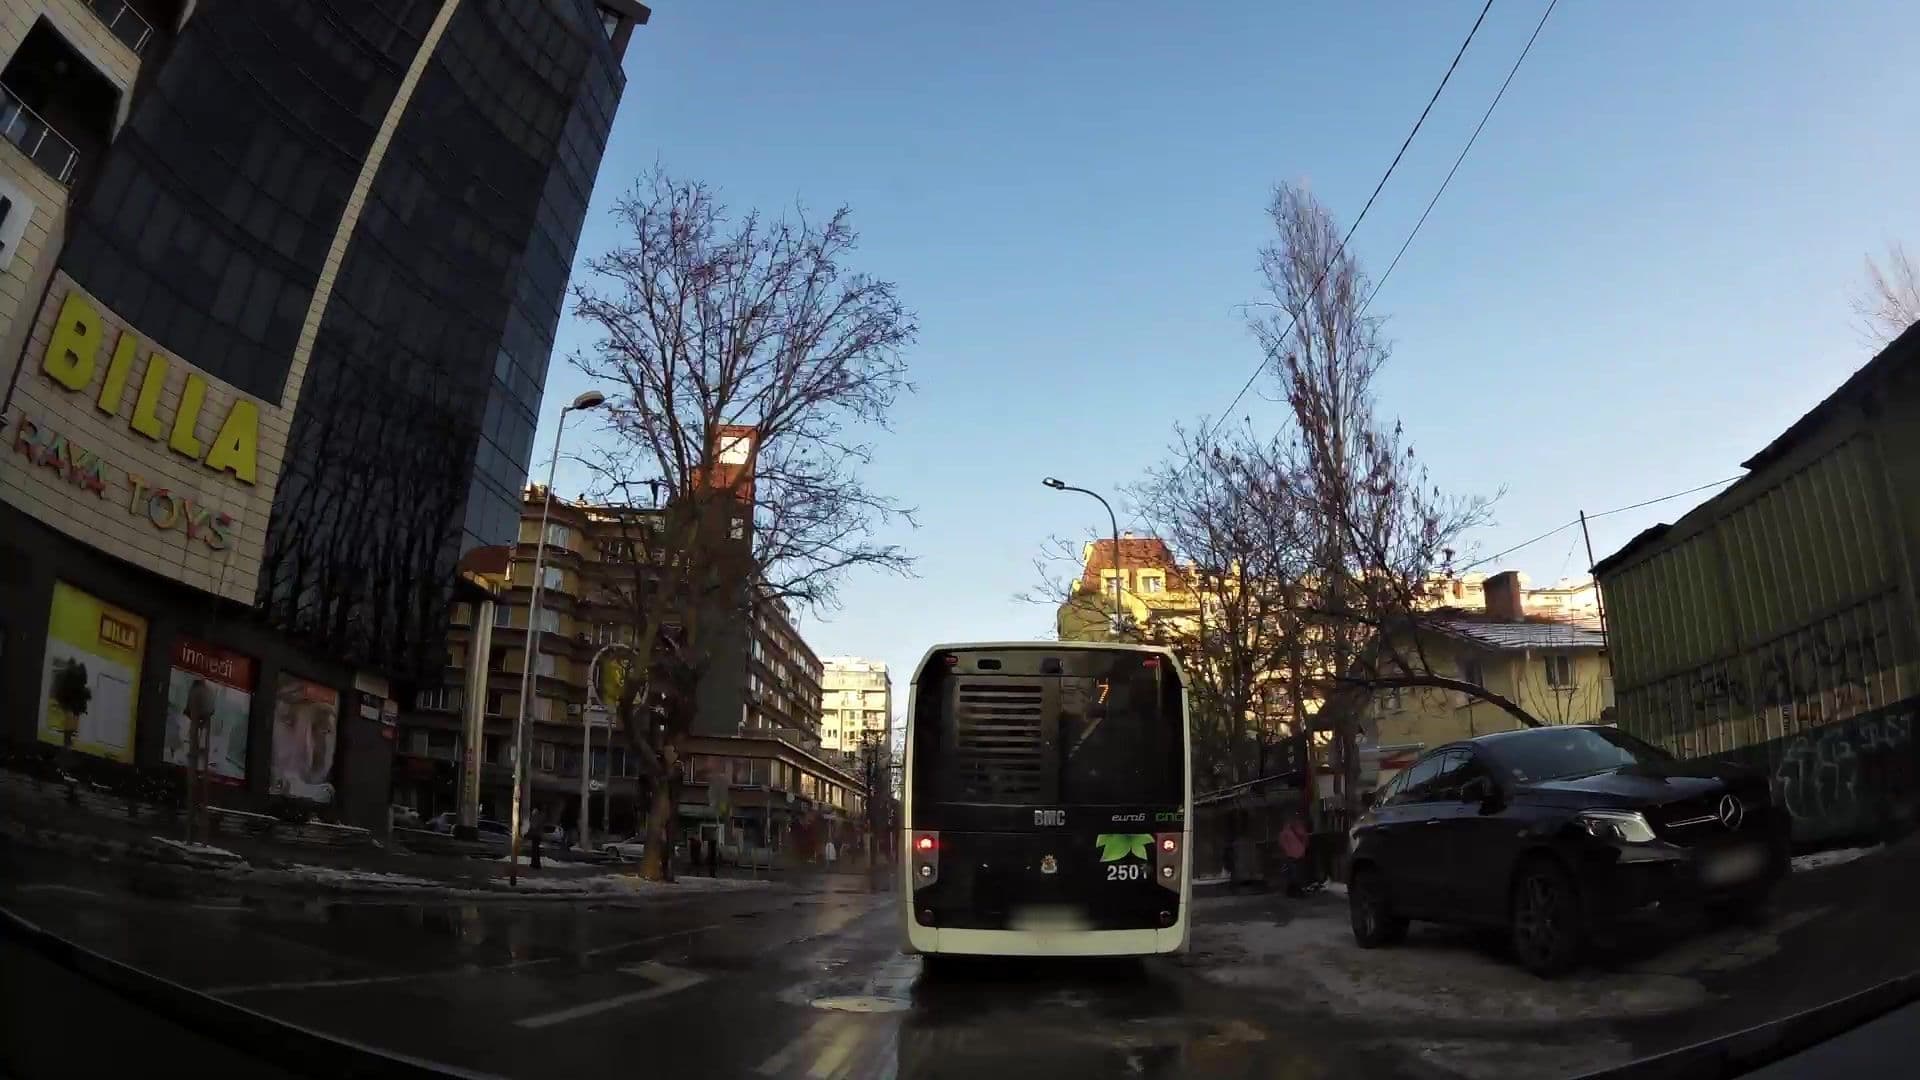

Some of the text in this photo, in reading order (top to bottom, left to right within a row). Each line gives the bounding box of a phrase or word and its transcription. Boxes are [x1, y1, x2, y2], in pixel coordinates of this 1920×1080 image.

[43, 290, 259, 486] BILLA
[128, 472, 232, 550] TOYS
[1097, 682, 1110, 704] 7
[1034, 809, 1066, 827] BMC
